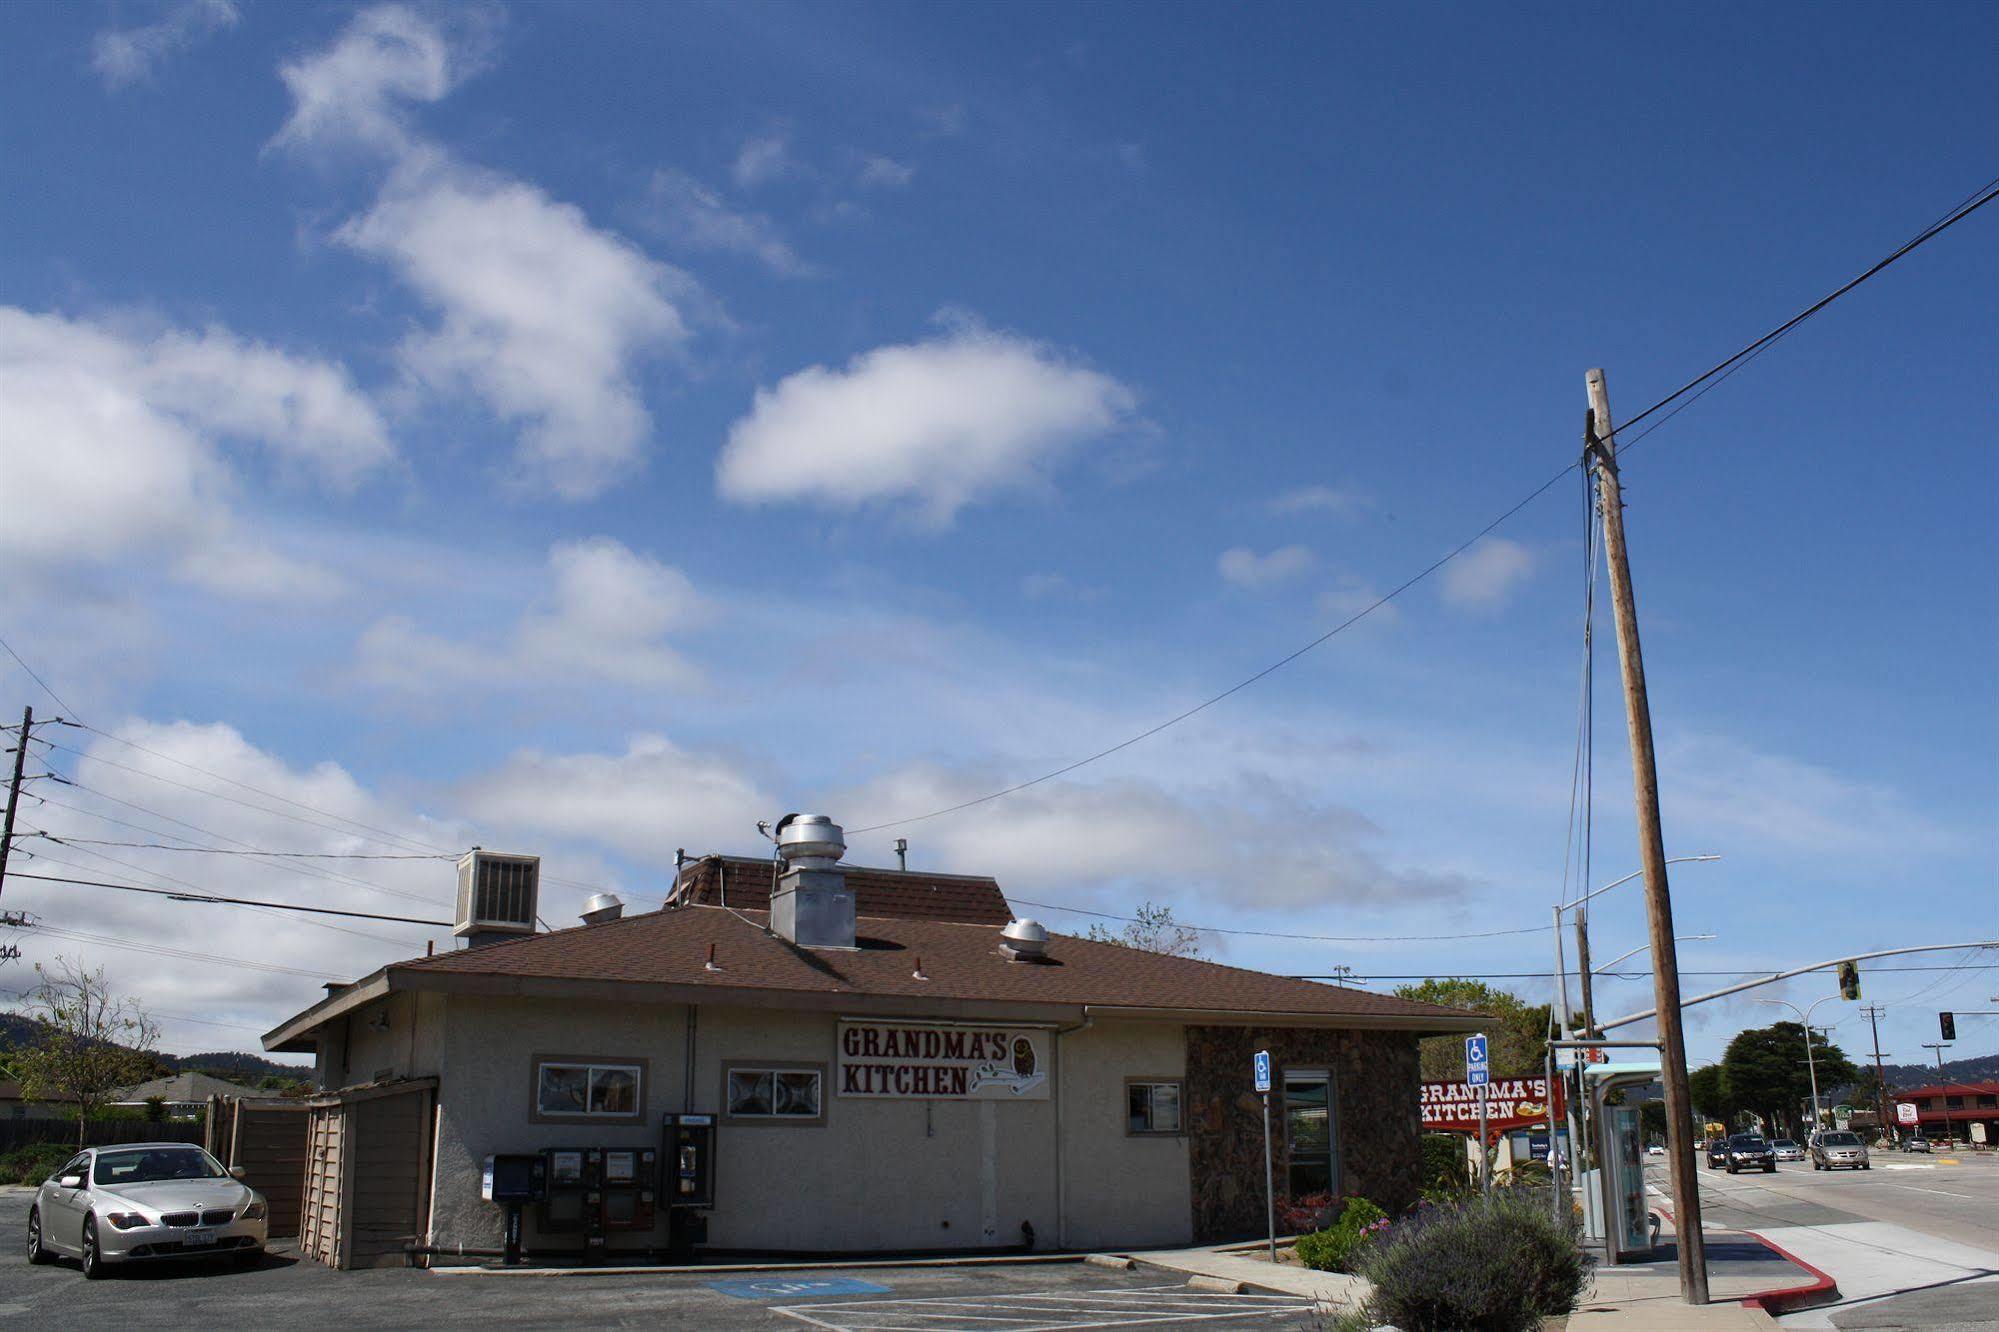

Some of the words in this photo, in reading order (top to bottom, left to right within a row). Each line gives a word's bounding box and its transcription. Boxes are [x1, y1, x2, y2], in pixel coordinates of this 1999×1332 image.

[843, 1027, 1008, 1061] GRANDMA'S
[842, 1064, 969, 1095] KITCHEN
[1472, 1072, 1484, 1083] ONLY
[1419, 1101, 1515, 1122] KITCHEN
